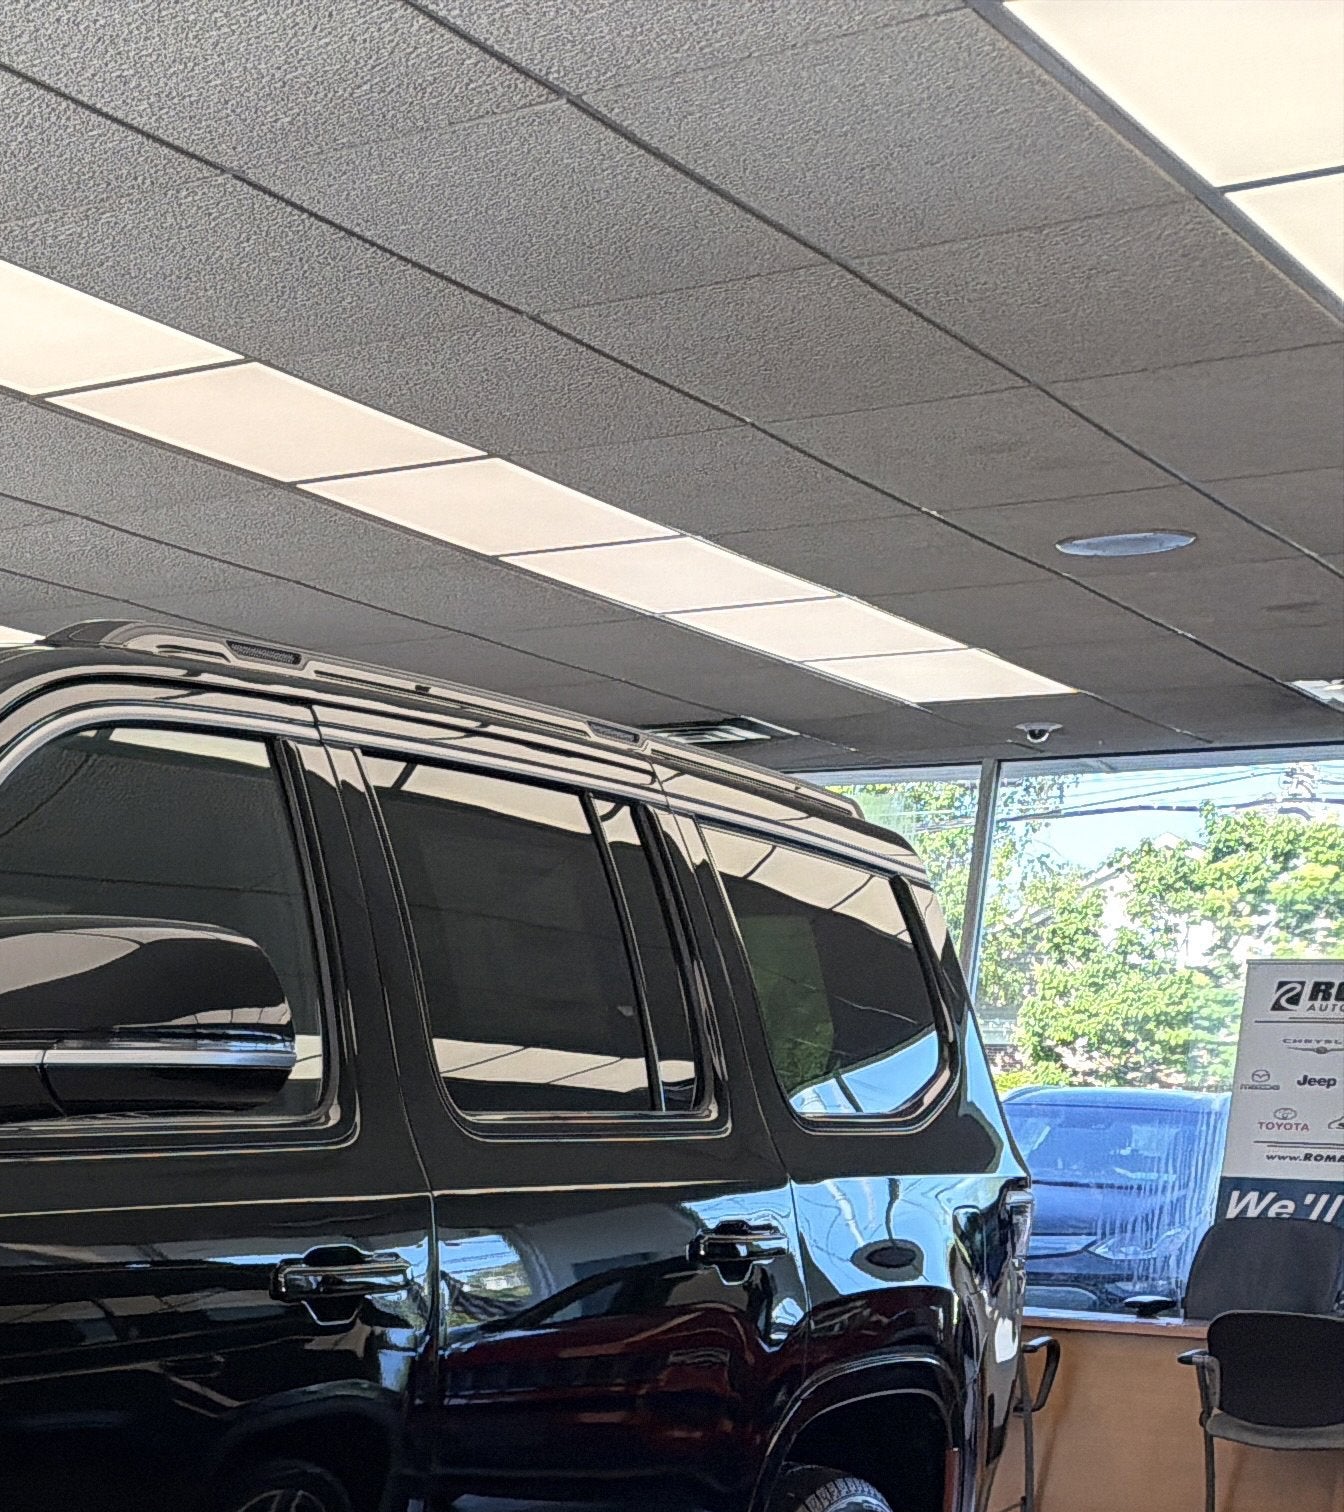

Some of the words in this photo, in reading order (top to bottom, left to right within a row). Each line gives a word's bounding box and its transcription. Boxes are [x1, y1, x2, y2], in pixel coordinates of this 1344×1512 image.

[1296, 1074, 1338, 1089] Jeep
[1257, 1121, 1310, 1132] TOYOTA
[1225, 1190, 1344, 1223] We'll
